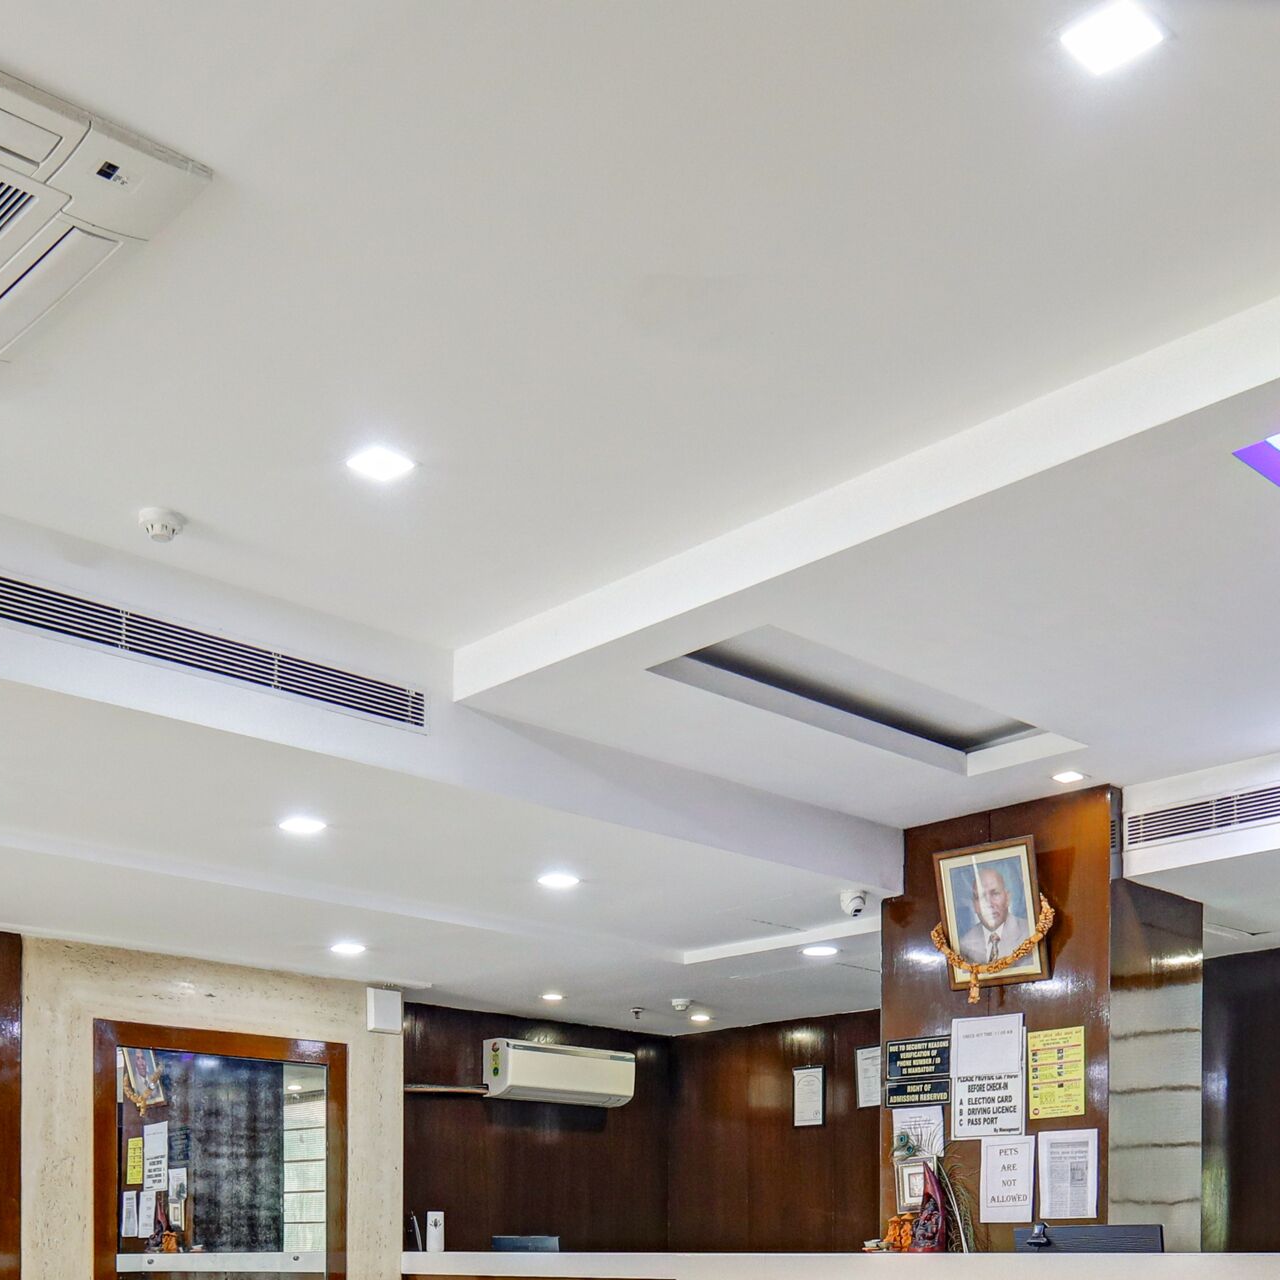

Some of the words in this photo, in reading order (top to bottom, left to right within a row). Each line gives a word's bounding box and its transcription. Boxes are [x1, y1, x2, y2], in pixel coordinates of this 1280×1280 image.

[906, 1085, 923, 1093] RIGHT
[924, 1084, 931, 1092] OF
[967, 1084, 985, 1093] BEFORE
[986, 1082, 1008, 1091] CHECK-IN
[889, 1094, 918, 1103] ADMISSION
[920, 1092, 948, 1101] RESERVED
[959, 1098, 963, 1106] A
[967, 1097, 995, 1105] ELECTION
[997, 1095, 1012, 1103] CARD
[967, 1107, 991, 1115] DRIVING
[992, 1105, 1017, 1114] LICENCE
[967, 1118, 981, 1126] PASS
[982, 1117, 998, 1125] PORT
[999, 1148, 1019, 1156] PETS
[1000, 1163, 1017, 1172] ARE
[1001, 1179, 1016, 1187] NOT
[990, 1193, 1028, 1203] ALLOWED
